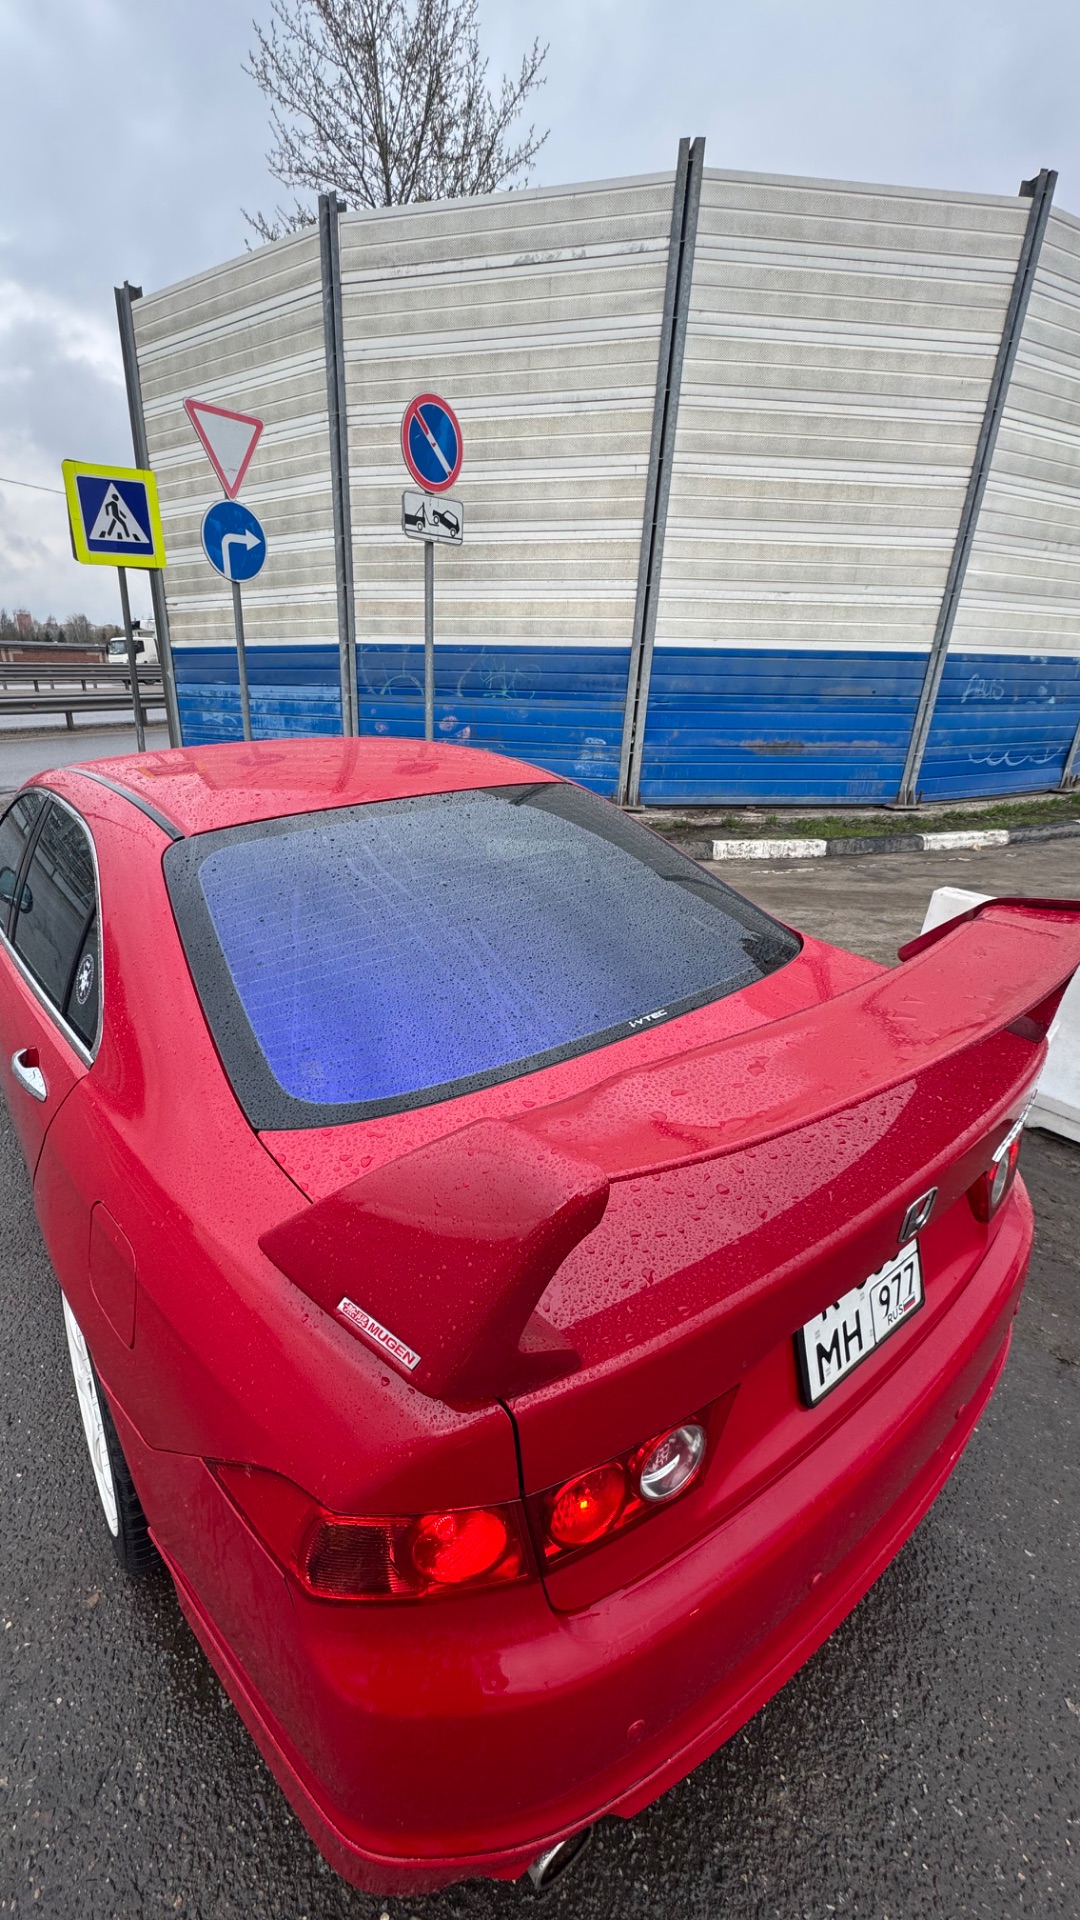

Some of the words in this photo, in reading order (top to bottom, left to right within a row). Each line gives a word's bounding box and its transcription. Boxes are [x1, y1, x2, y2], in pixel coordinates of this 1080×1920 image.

[878, 1261, 915, 1320] 977
[886, 1304, 904, 1327] RUS
[367, 1323, 416, 1365] MUGEN
